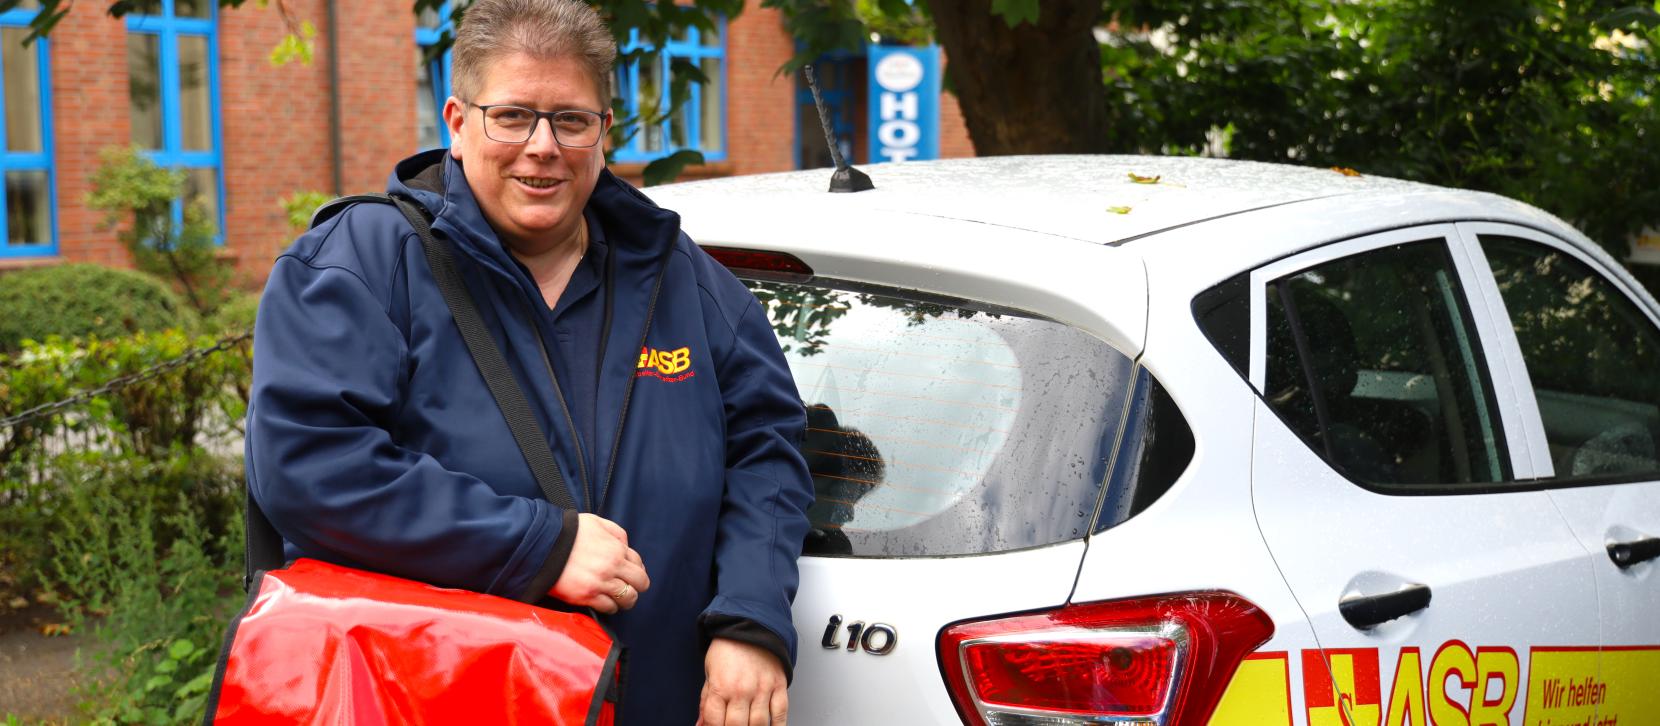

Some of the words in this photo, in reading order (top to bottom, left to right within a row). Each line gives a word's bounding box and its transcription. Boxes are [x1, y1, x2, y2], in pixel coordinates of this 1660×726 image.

[647, 347, 691, 375] ASB
[821, 614, 898, 656] i10
[1543, 679, 1565, 709] Wir
[1567, 676, 1606, 707] helfen
